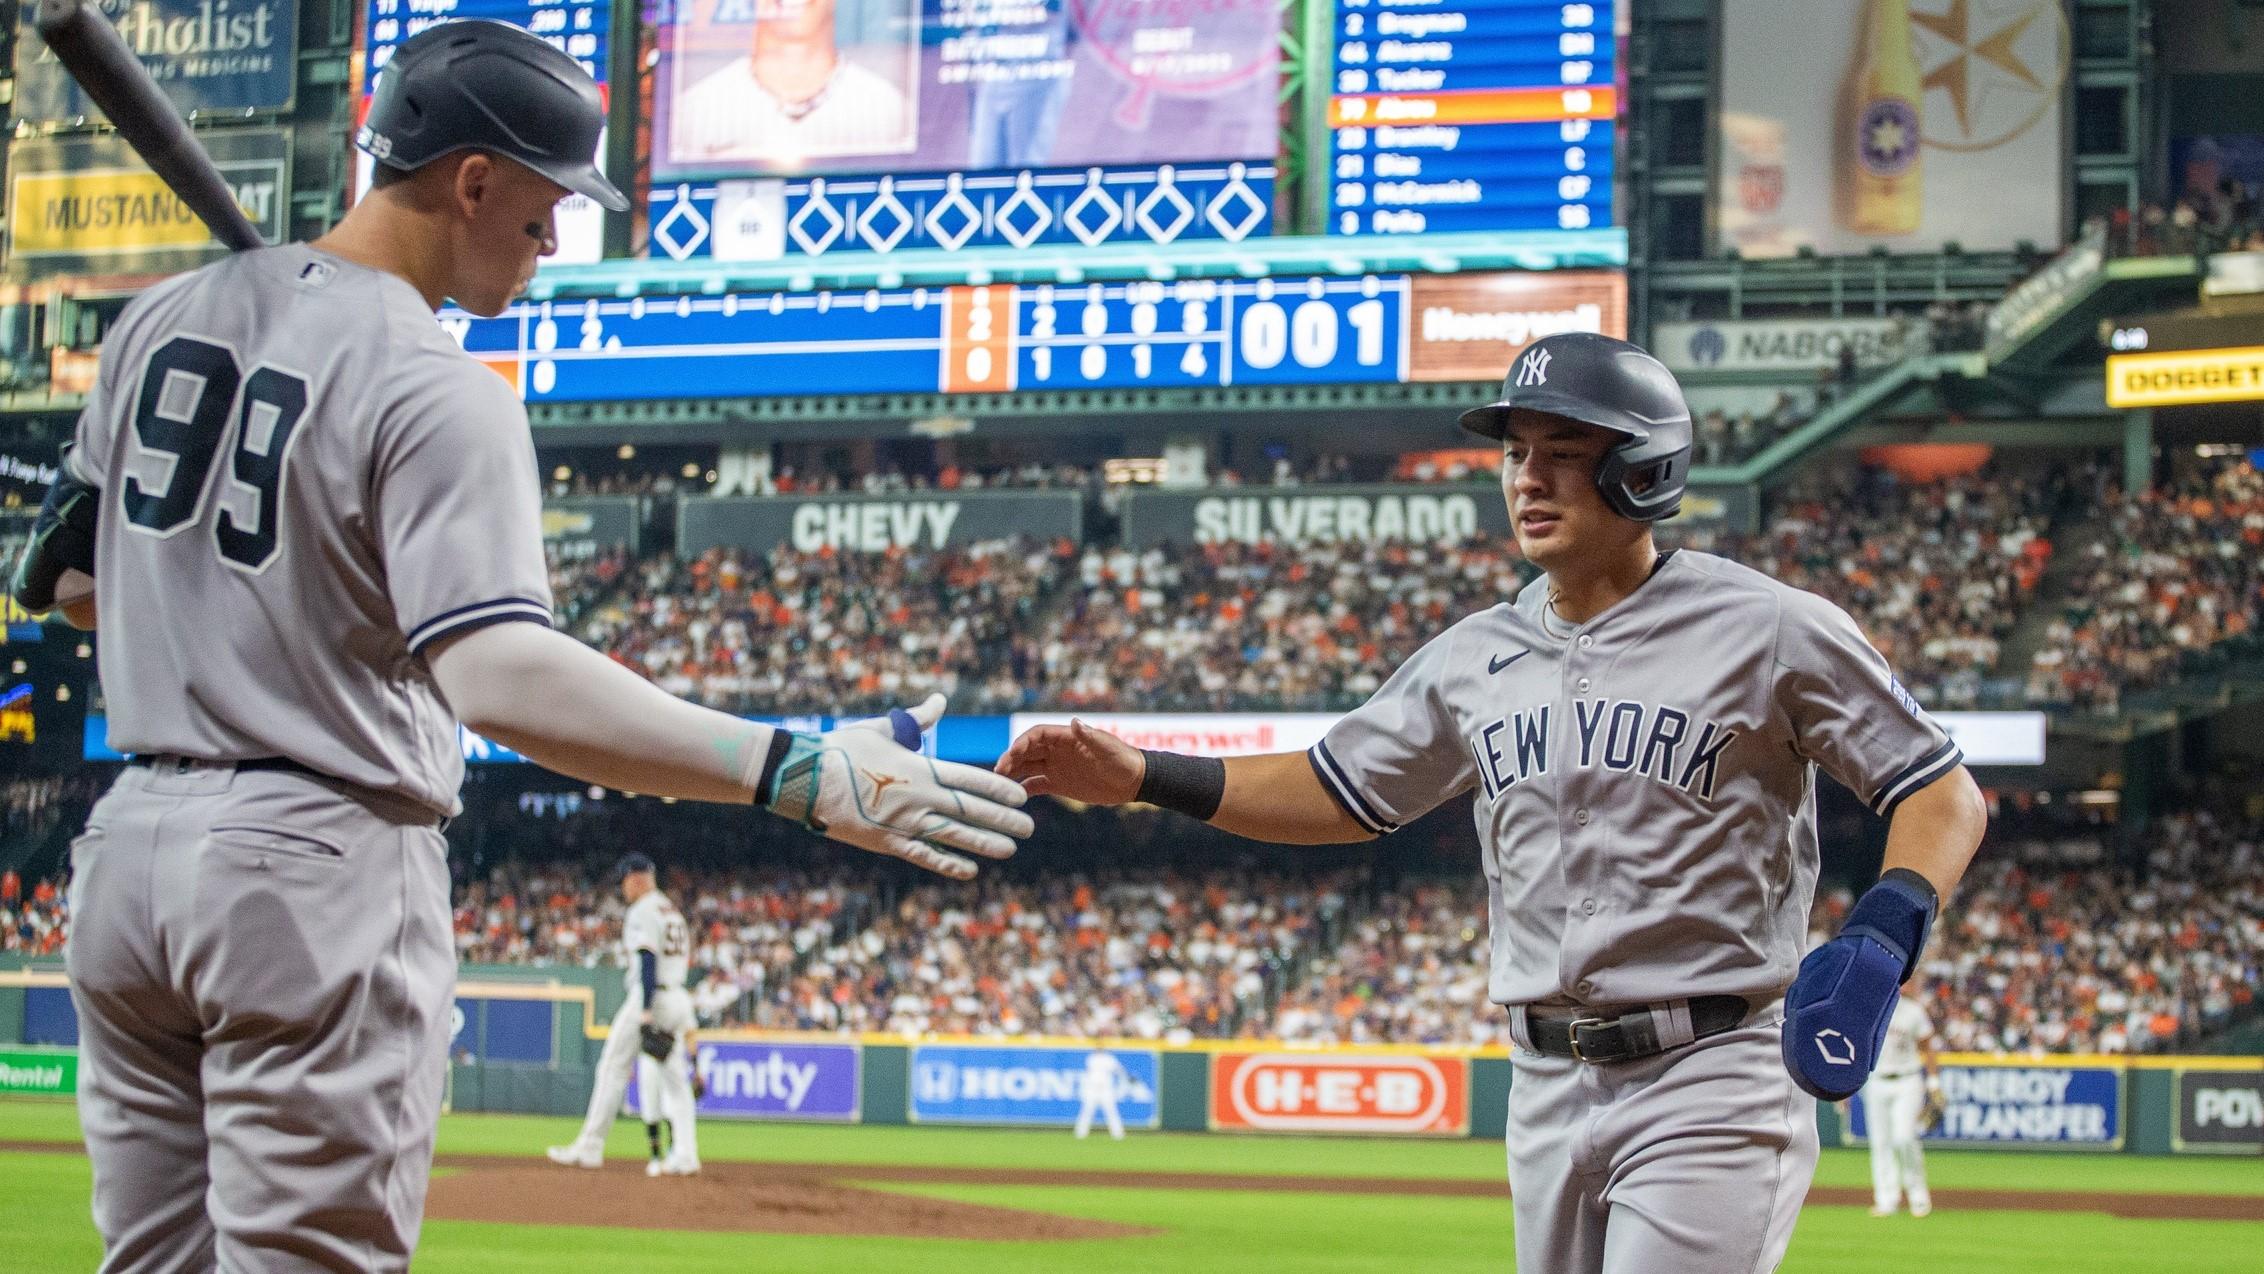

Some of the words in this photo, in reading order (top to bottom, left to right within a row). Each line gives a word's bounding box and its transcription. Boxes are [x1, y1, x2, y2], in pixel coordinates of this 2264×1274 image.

[46, 191, 195, 231] MUSTANG
[238, 183, 274, 224] AT
[535, 319, 557, 352] 0
[580, 318, 603, 352] 2
[968, 306, 992, 341] 2
[1031, 304, 1057, 339] 2
[1082, 303, 1108, 337] 0
[1131, 303, 1158, 336] 0
[1422, 304, 1602, 345] Honeywell
[533, 360, 557, 394] 0
[966, 347, 992, 382] 0
[1031, 346, 1052, 381] 1
[1080, 345, 1107, 380] 0
[1131, 343, 1152, 379] 1
[1180, 342, 1207, 377] 4
[1516, 347, 1552, 387] NY
[119, 330, 314, 577] 99
[793, 502, 960, 554] CHEVY
[1194, 495, 1478, 545] SILVERADO
[1100, 722, 1275, 756] oneywell
[1571, 698, 1740, 802] YORK
[698, 1046, 818, 1112] finity
[962, 1066, 1154, 1104] HONA
[1940, 1069, 2072, 1105] ENERGY
[1942, 1104, 2106, 1138] TRANSFER
